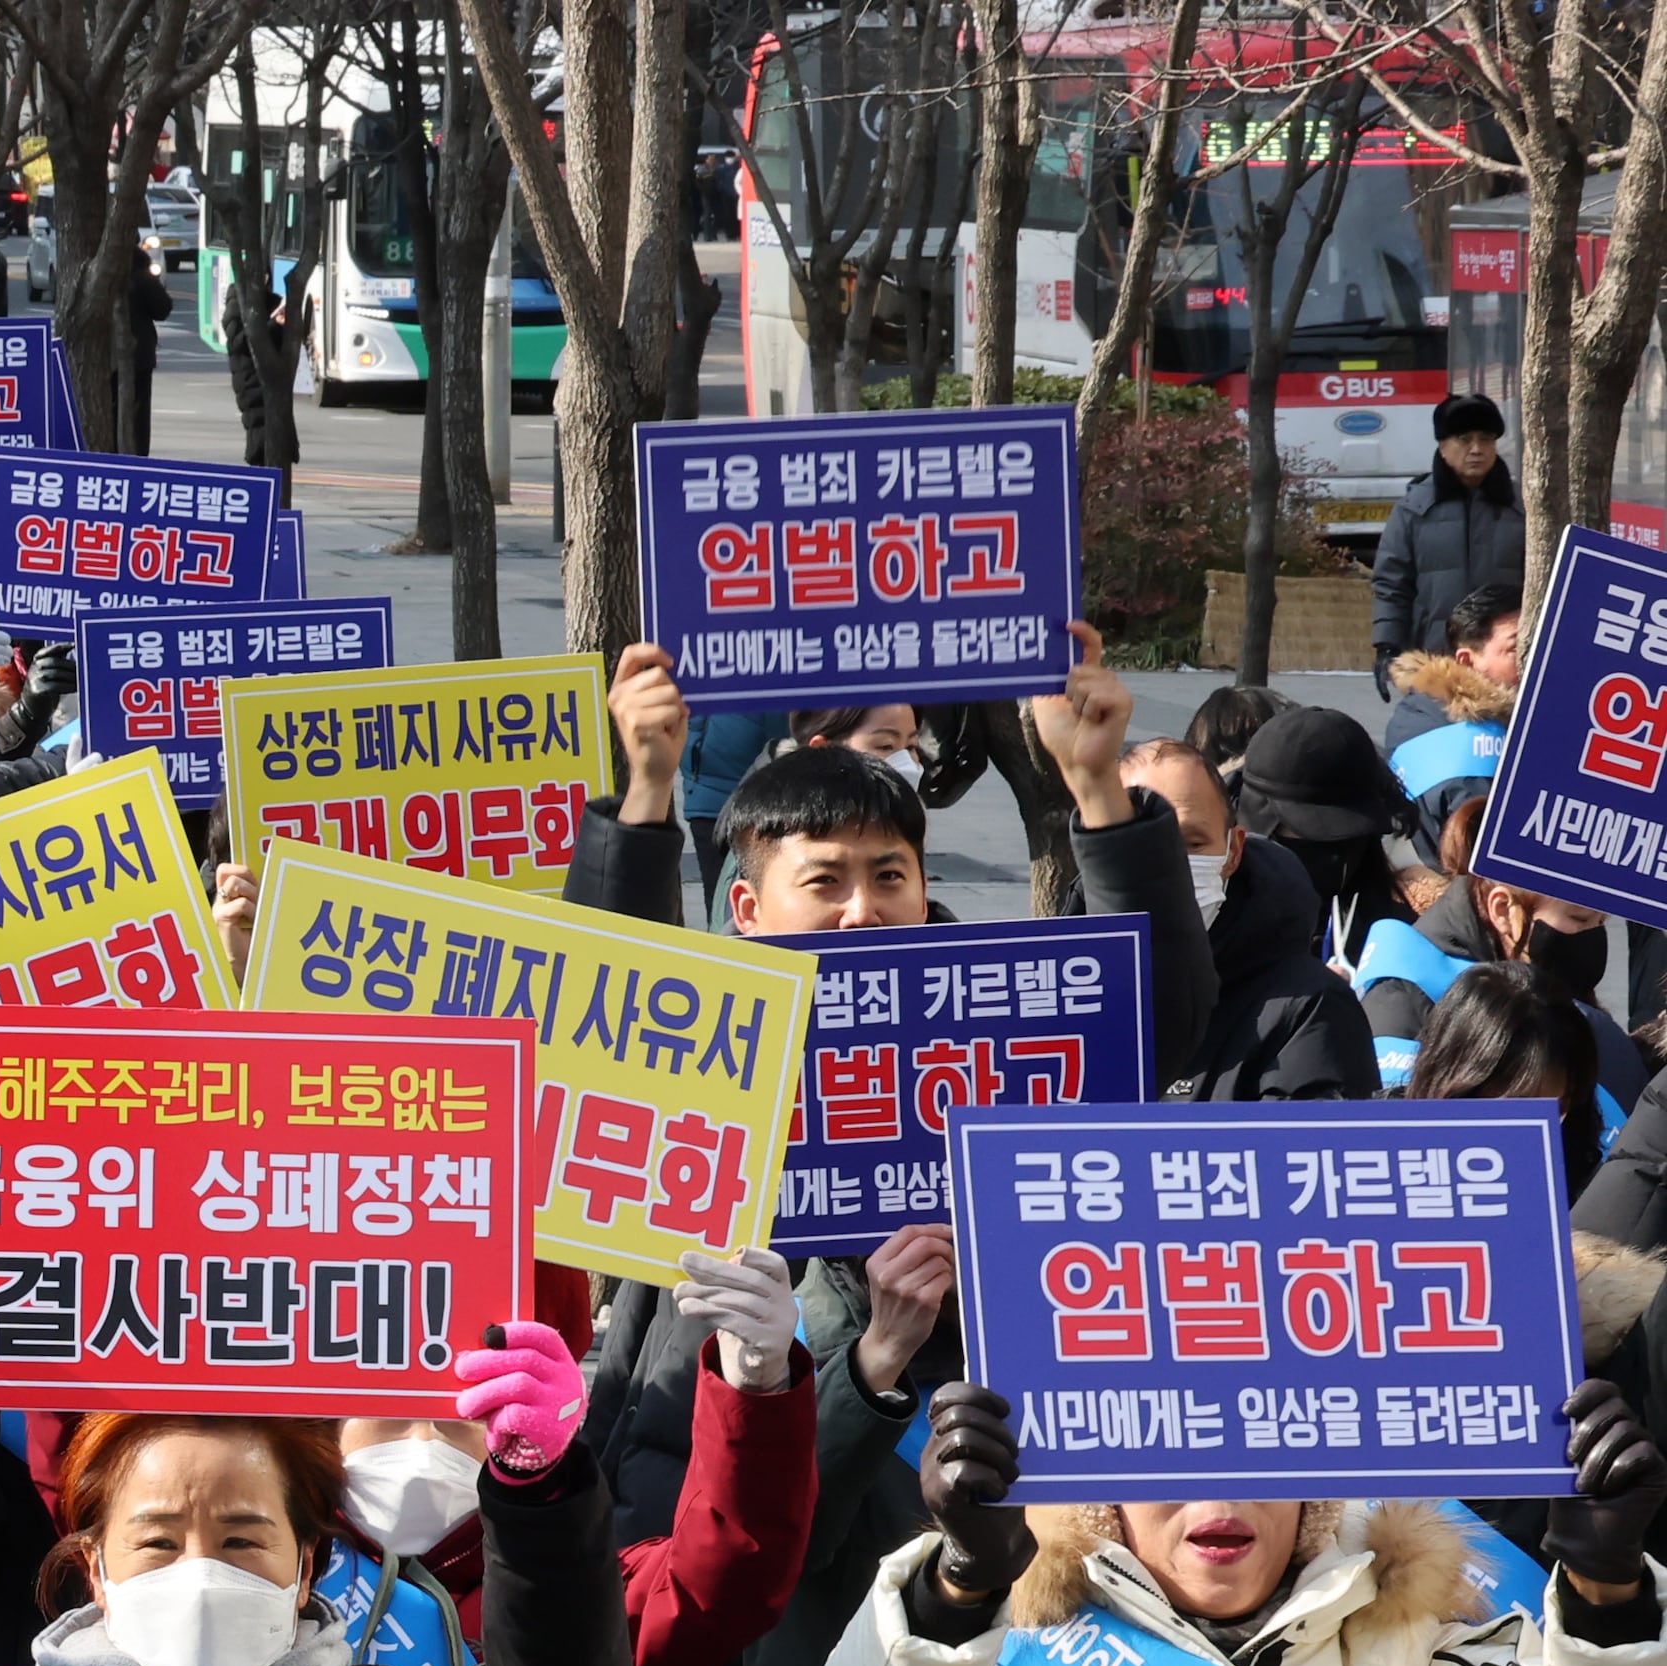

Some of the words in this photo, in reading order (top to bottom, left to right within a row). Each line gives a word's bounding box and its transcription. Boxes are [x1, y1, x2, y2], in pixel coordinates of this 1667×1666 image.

[11, 470, 63, 506] 금융
[76, 477, 129, 515] 범죄
[141, 481, 249, 524] 카르텔은
[682, 454, 761, 513] 금융
[780, 448, 857, 507] 범죄
[876, 441, 1035, 501] 카르텔은
[15, 514, 235, 587] 엄벌하고
[699, 510, 1026, 614] 엄벌하고
[108, 632, 164, 670] 금융
[178, 628, 234, 665] 범죄
[247, 623, 363, 663] 카르텔은
[676, 628, 824, 680] 시민에게는
[833, 621, 921, 672] 일상을
[932, 614, 1049, 668] 돌려달라
[256, 706, 341, 779] 상장
[355, 698, 440, 772] 폐지
[455, 690, 581, 763] 사유서
[298, 898, 428, 1012] 상장
[572, 964, 767, 1092] 사유서
[815, 967, 900, 1030] 범죄
[923, 955, 1104, 1021] 카르텔은
[286, 1061, 489, 1133] 보호없는
[191, 1149, 492, 1239] 상폐정책
[1014, 1149, 1124, 1223] 금융
[1150, 1149, 1262, 1223] 범죄
[1286, 1145, 1509, 1219] 카르텔은
[1041, 1238, 1504, 1363] 엄벌하고
[1017, 1389, 1225, 1453] 시민에게는
[1238, 1386, 1362, 1450] 일상을
[1376, 1385, 1540, 1448] 돌려달라
